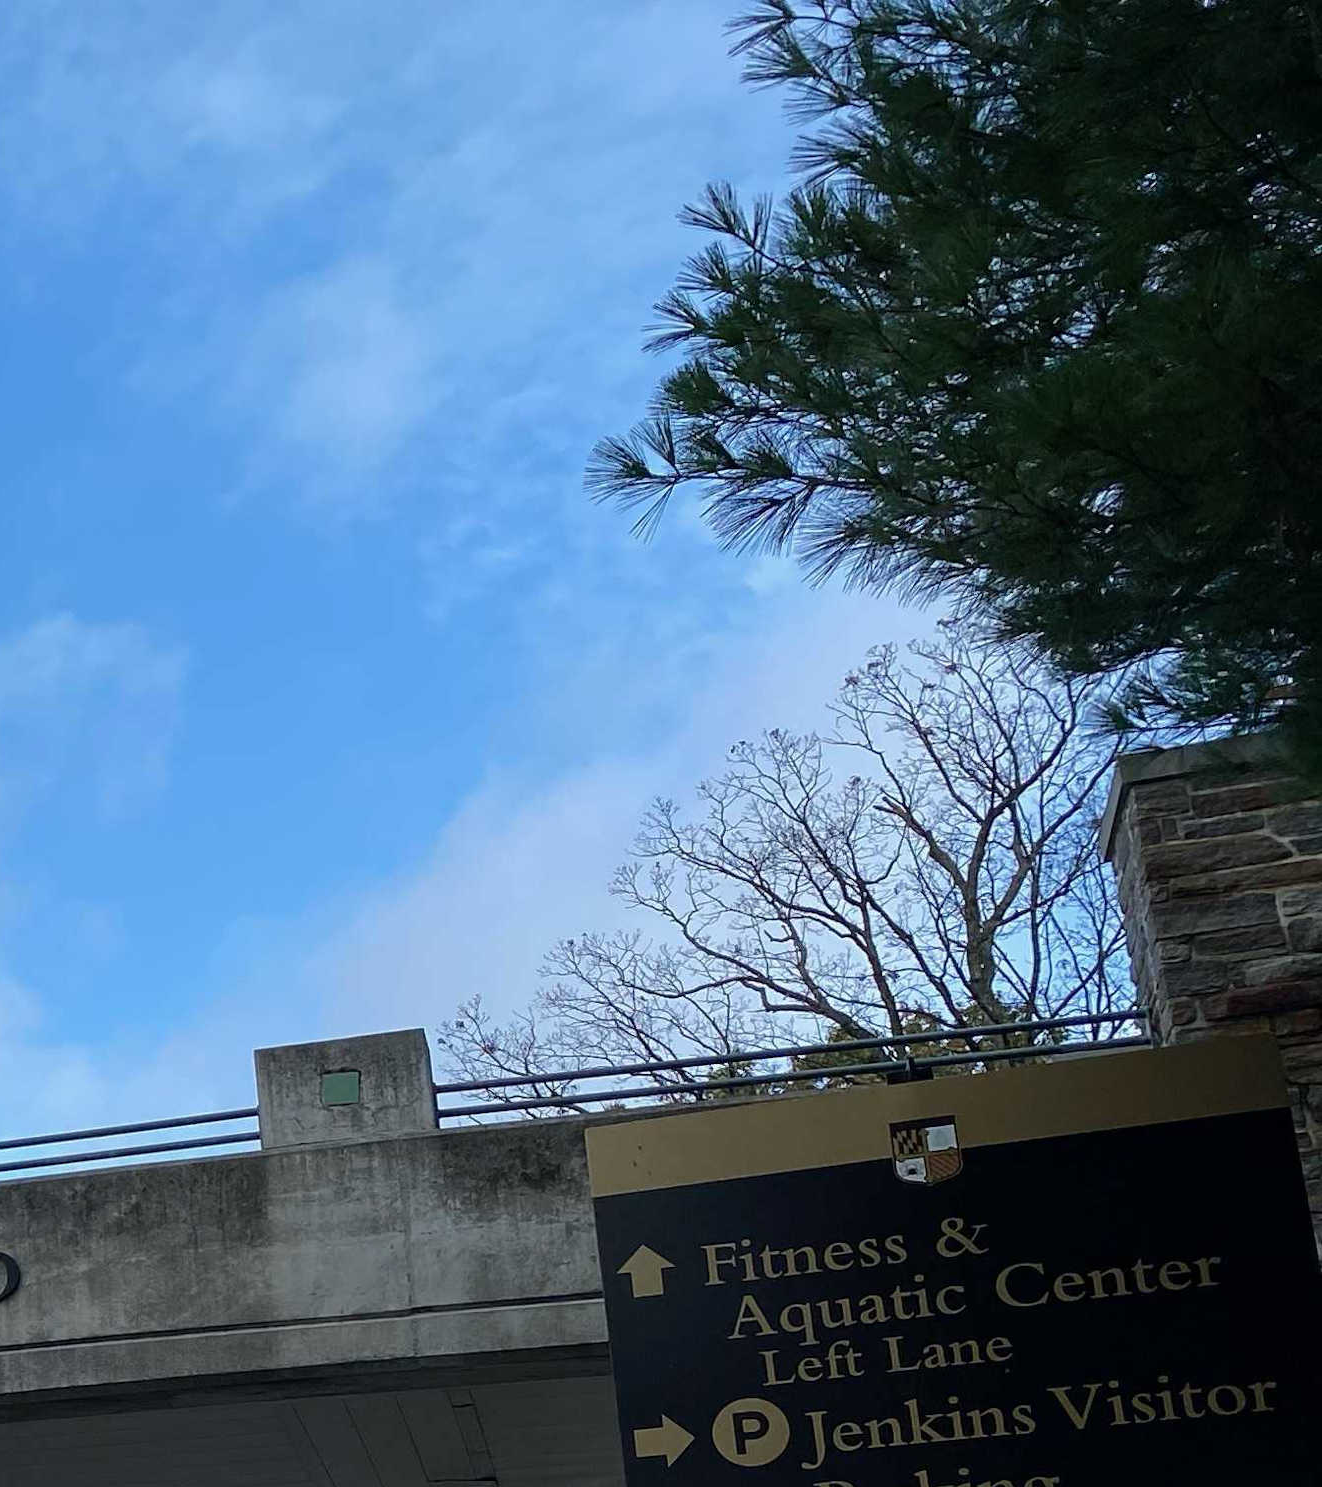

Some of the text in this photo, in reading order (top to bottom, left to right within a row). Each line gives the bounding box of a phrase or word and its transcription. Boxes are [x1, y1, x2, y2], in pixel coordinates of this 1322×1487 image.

[701, 1217, 989, 1286] Fitness &
[727, 1257, 1220, 1346] Aquatic Center
[759, 1336, 1012, 1386] Left Lane
[801, 1376, 1276, 1469] Jenkins Visitor
